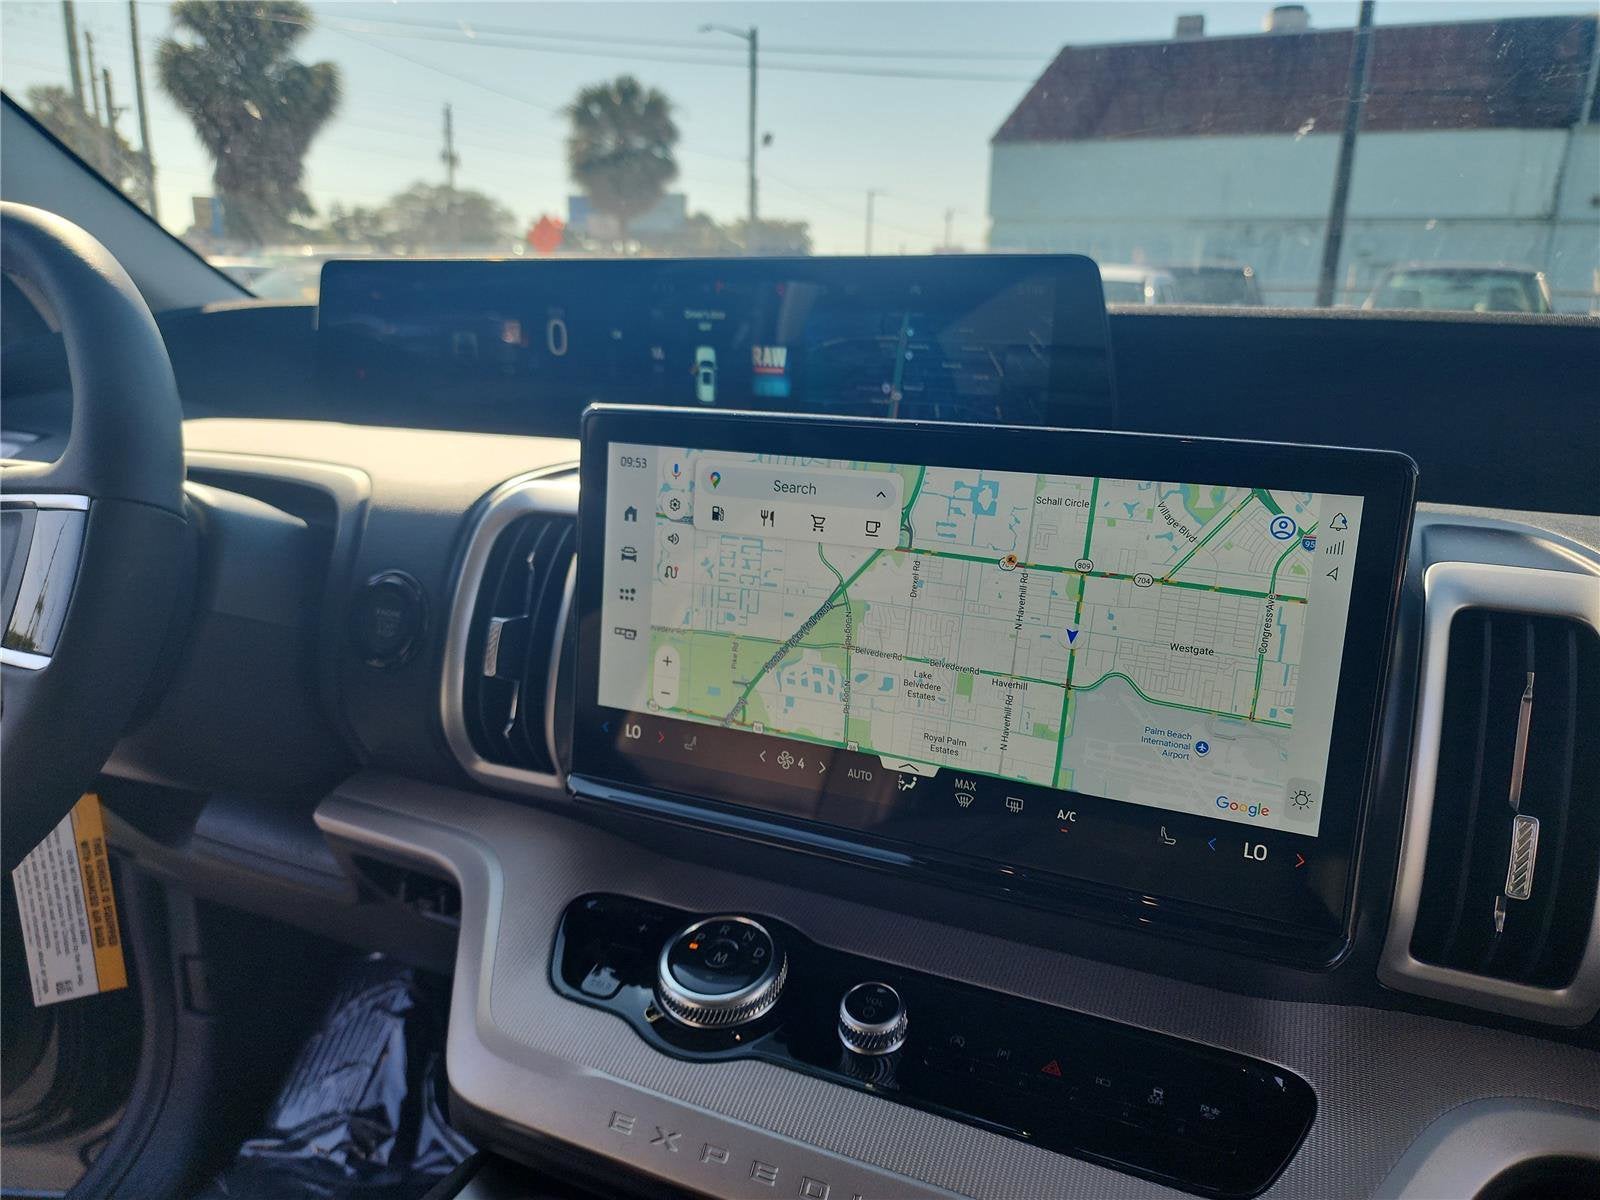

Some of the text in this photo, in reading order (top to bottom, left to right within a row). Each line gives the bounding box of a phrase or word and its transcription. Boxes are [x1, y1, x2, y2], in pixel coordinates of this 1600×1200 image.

[752, 347, 787, 367] RAW
[620, 456, 648, 469] 09:53
[773, 480, 817, 495] Search
[1036, 496, 1090, 508] Schall Circle
[1158, 501, 1197, 542] Village Blvd
[1304, 540, 1315, 548] 95
[1077, 562, 1091, 570] 809
[910, 560, 921, 598] Drexel Rd
[1020, 572, 1028, 583] Rd
[1136, 576, 1151, 585] 704
[1016, 585, 1027, 622] Haverhill
[1258, 594, 1275, 654] Congress Ave
[855, 647, 903, 661] Belvedere Rd
[1170, 643, 1214, 657] Westgate
[913, 670, 932, 679] Lake
[929, 659, 980, 676] Belvedere Rd
[903, 679, 941, 692] Belvedere
[992, 678, 1028, 691] Haverhill
[907, 690, 936, 702] Estates
[1000, 695, 1013, 751] N Haverhill Rd
[625, 724, 641, 739] LO
[1144, 726, 1192, 741] Palm Beach
[923, 733, 967, 747] Royal Palm
[1141, 736, 1191, 750] International
[930, 744, 959, 756] Estates
[1162, 748, 1190, 760] Airport
[797, 758, 805, 769] 4
[847, 768, 872, 782] AUTO
[954, 778, 977, 792] MAX
[1216, 795, 1270, 817] Google
[1057, 809, 1077, 823] A/C
[1243, 842, 1268, 861] LO
[713, 951, 729, 963] M
[753, 947, 765, 957] D
[609, 1110, 863, 1200] EXPED
